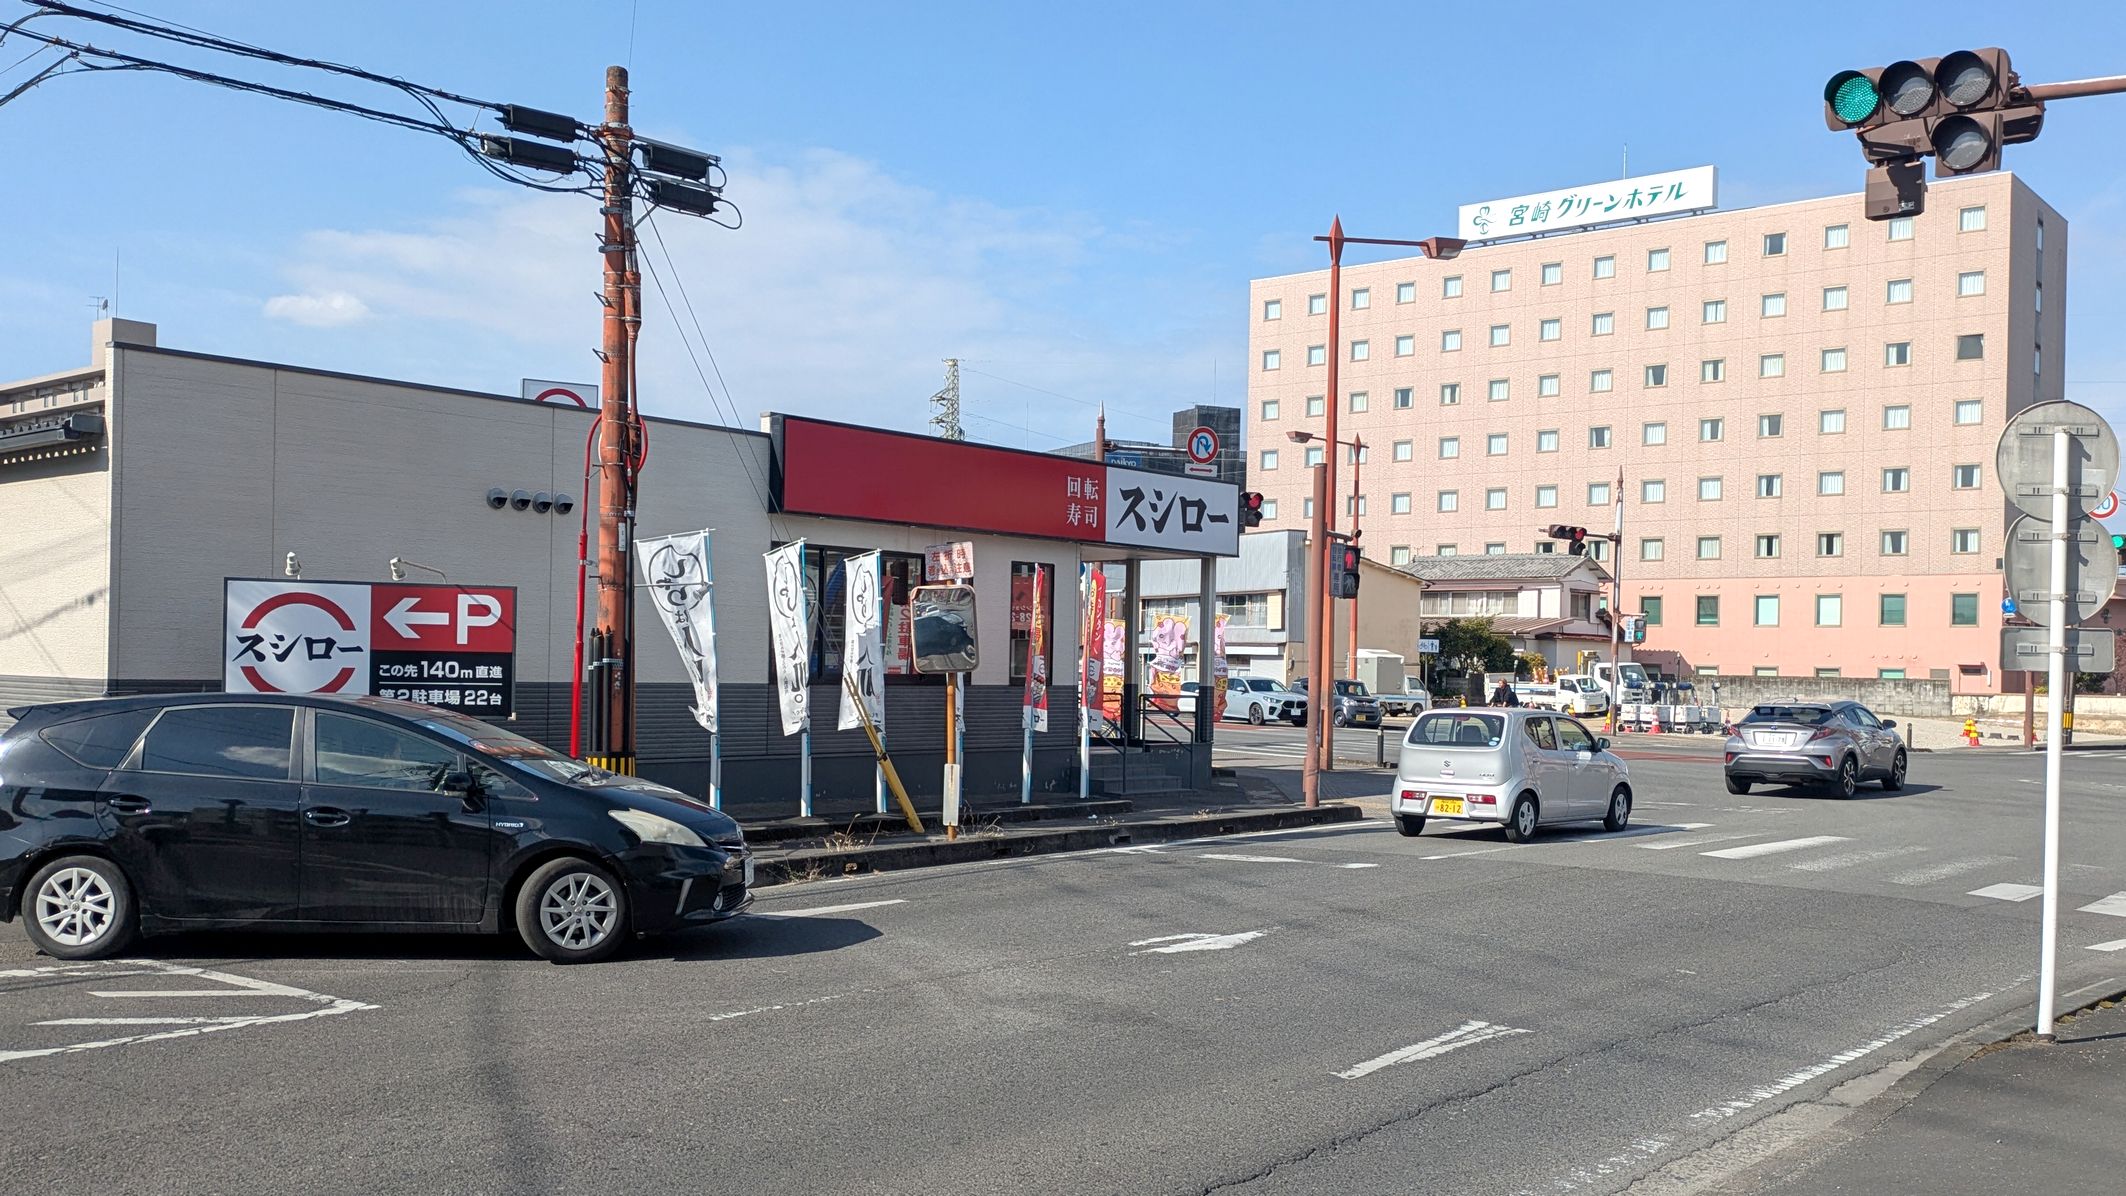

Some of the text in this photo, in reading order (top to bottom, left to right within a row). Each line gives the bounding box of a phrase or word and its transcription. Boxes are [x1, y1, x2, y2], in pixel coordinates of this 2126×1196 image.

[1508, 181, 1688, 227] 宮崎グリーンホテル
[1067, 476, 1099, 501] 回転
[1066, 502, 1098, 529] 寿司
[1116, 486, 1230, 534] スシロー
[456, 593, 502, 645] P
[232, 633, 364, 663] スシロー
[379, 661, 503, 679] この先 140m 直進
[464, 690, 502, 706] 22台
[1440, 804, 1462, 814] 82-12
